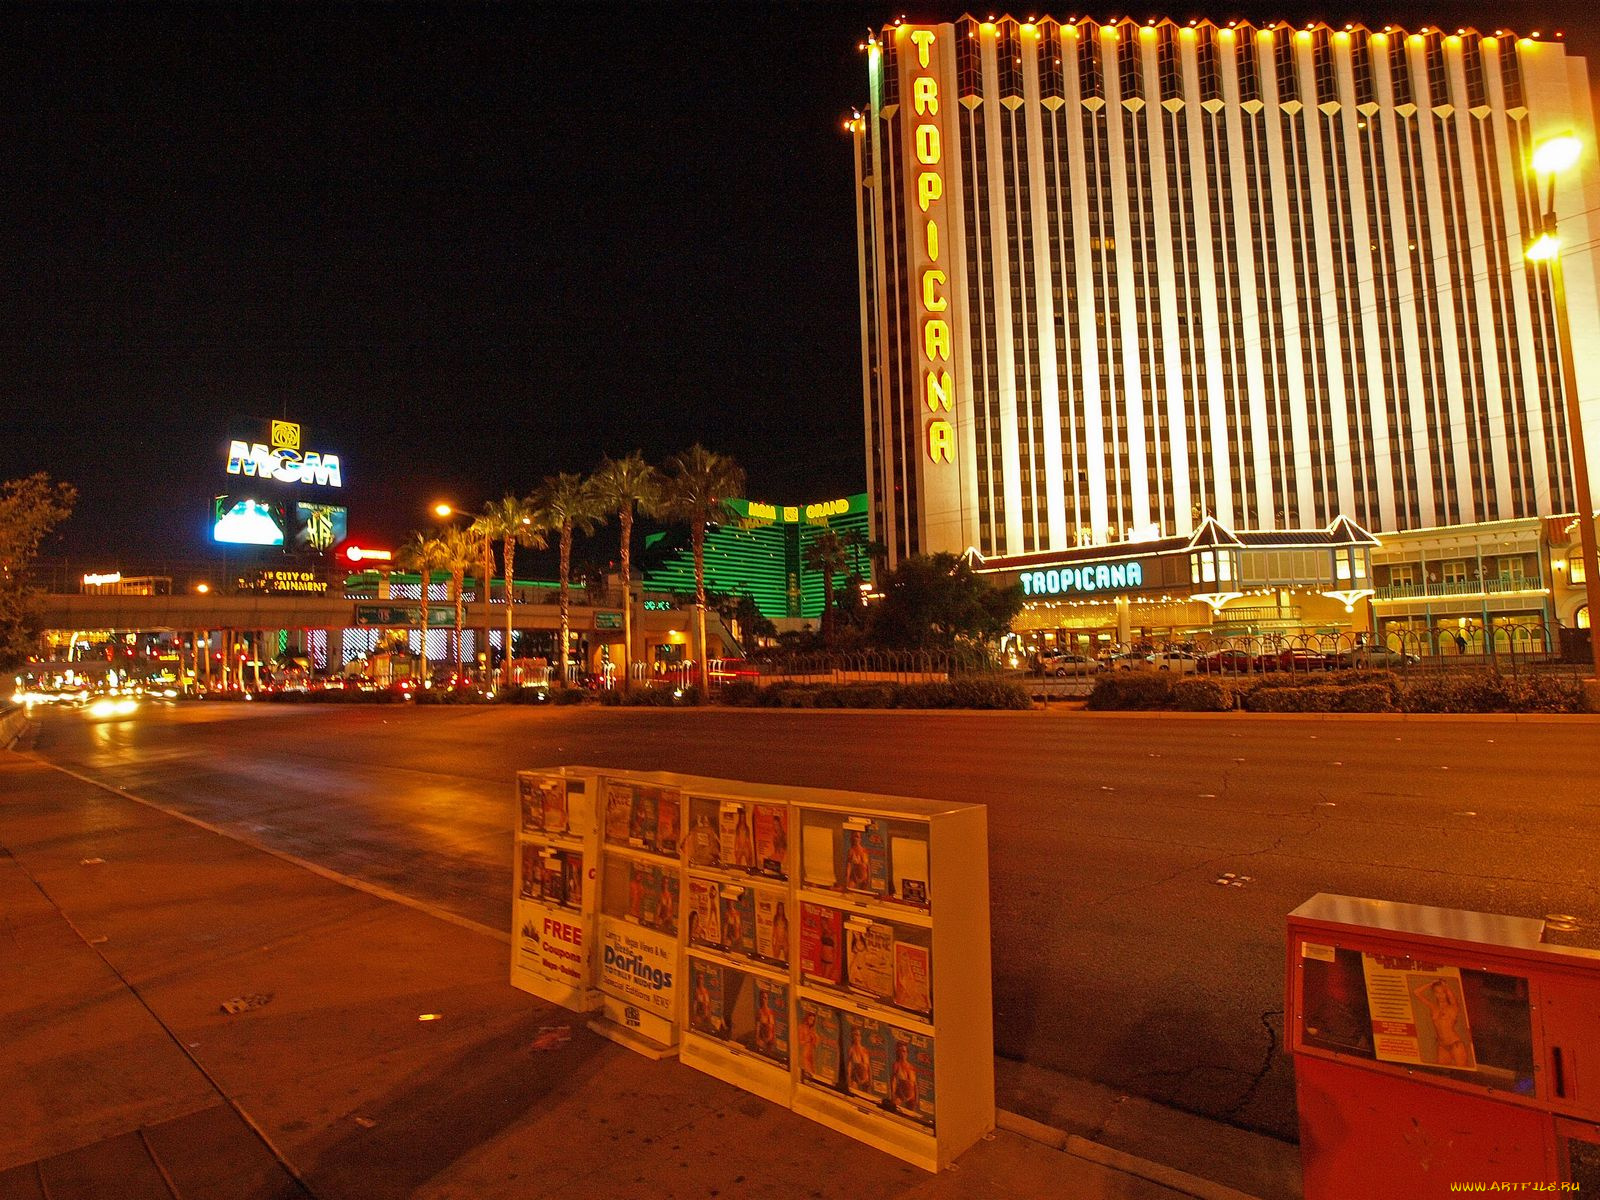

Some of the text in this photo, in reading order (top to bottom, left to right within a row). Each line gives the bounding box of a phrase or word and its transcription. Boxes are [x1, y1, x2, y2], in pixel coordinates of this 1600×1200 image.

[911, 30, 955, 464] TROPICANA
[227, 440, 342, 488] MGM
[748, 499, 850, 520] MGM GRAND
[1020, 562, 1142, 595] TROPICANA
[543, 917, 583, 946] FREE
[542, 941, 581, 963] Coupons
[604, 944, 673, 990] Darlings
